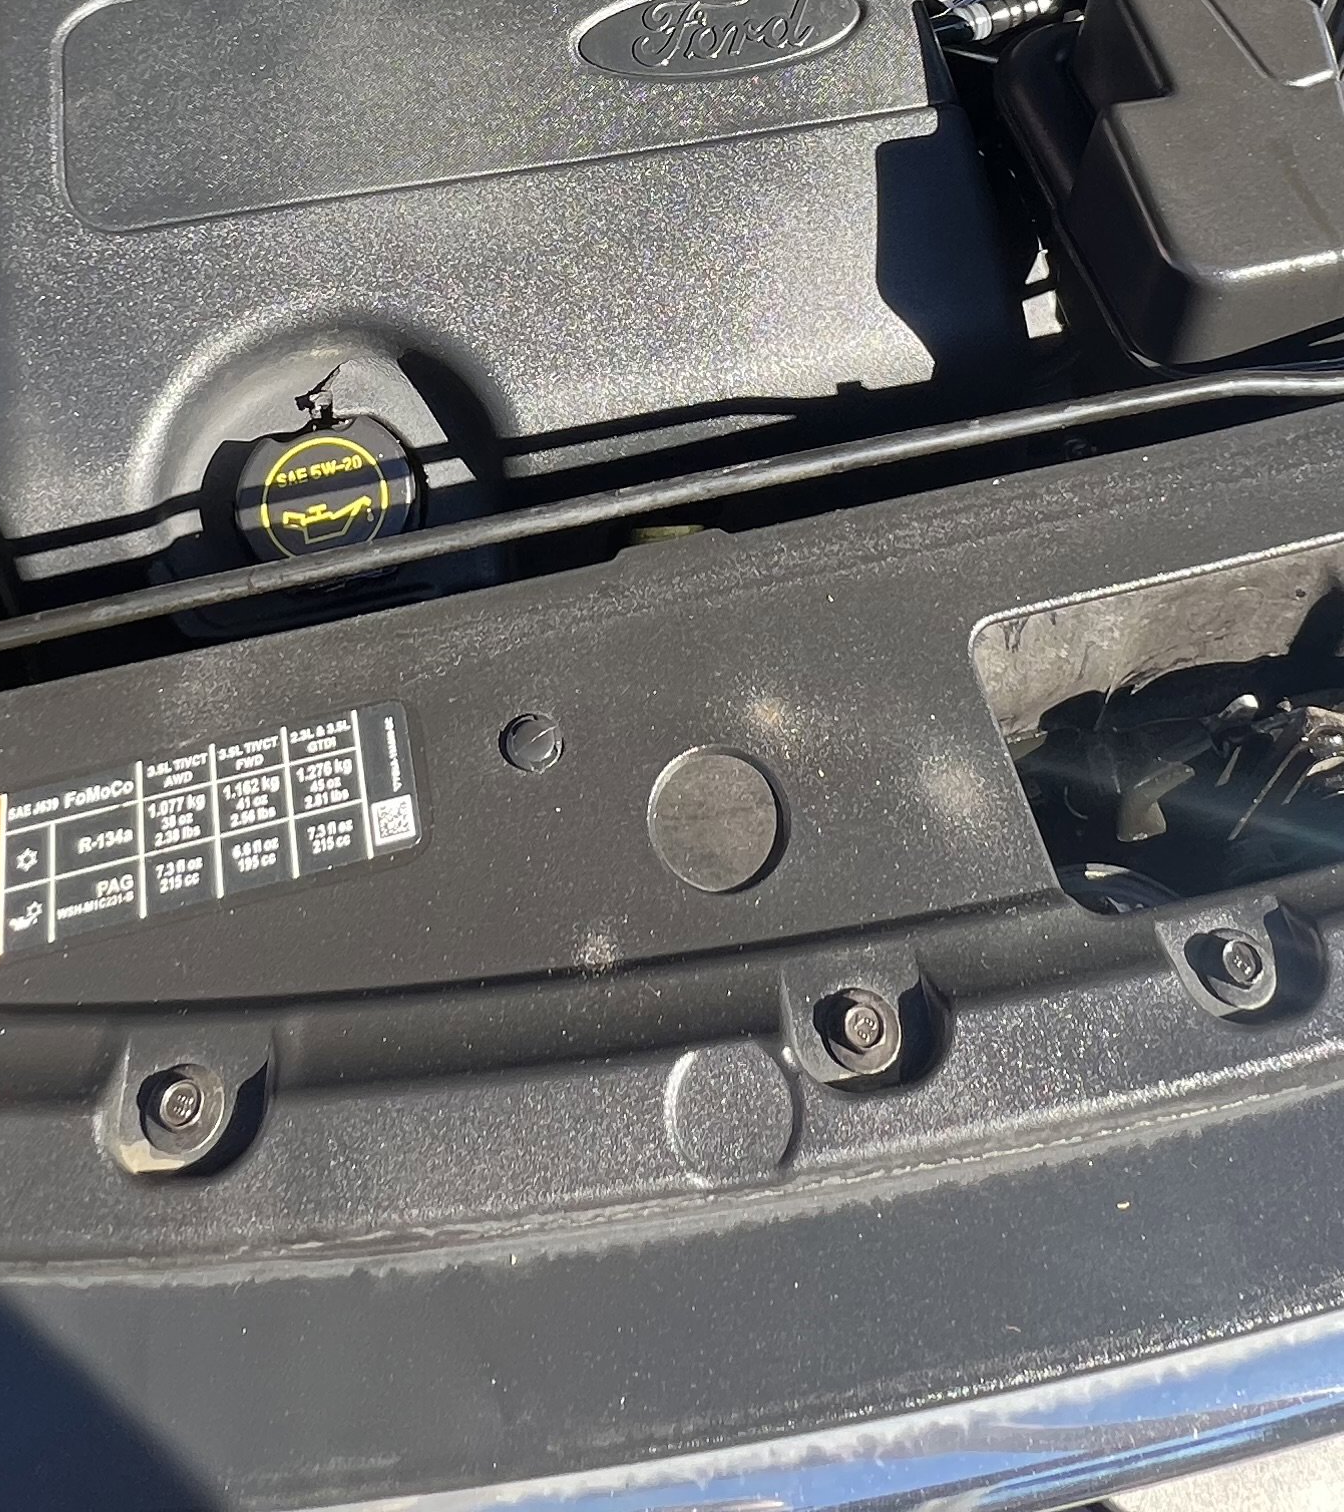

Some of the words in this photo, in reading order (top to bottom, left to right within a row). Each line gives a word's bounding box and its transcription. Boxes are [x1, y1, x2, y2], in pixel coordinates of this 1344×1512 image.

[276, 467, 307, 488] SAE
[310, 454, 363, 480] 5W-20
[236, 753, 264, 771] FWD
[296, 760, 332, 783] 1.276
[334, 757, 352, 775] kg
[164, 770, 193, 788] AWD
[261, 775, 280, 793] kg
[326, 776, 341, 790] oz
[8, 803, 31, 821] SAE
[64, 780, 134, 809] FoMoCo
[236, 796, 251, 811] 41
[252, 794, 269, 807] oz
[331, 789, 349, 803] lbs
[148, 796, 184, 818] 1.077
[186, 794, 206, 811] kg
[258, 806, 277, 820] lbs
[178, 812, 194, 826] oz
[327, 821, 337, 835] fl
[338, 819, 353, 833] oz
[78, 828, 133, 854] R-134a
[155, 830, 180, 847] 2.38
[182, 825, 201, 839] lbs
[263, 837, 279, 851] oz
[312, 836, 335, 854] 215
[336, 834, 351, 848] cc
[155, 861, 175, 879] 7.3
[176, 859, 186, 873] fl
[187, 857, 203, 871] oz
[261, 852, 277, 867] cc
[96, 874, 134, 898] PAG
[160, 874, 183, 894] 215
[184, 872, 200, 888] cc
